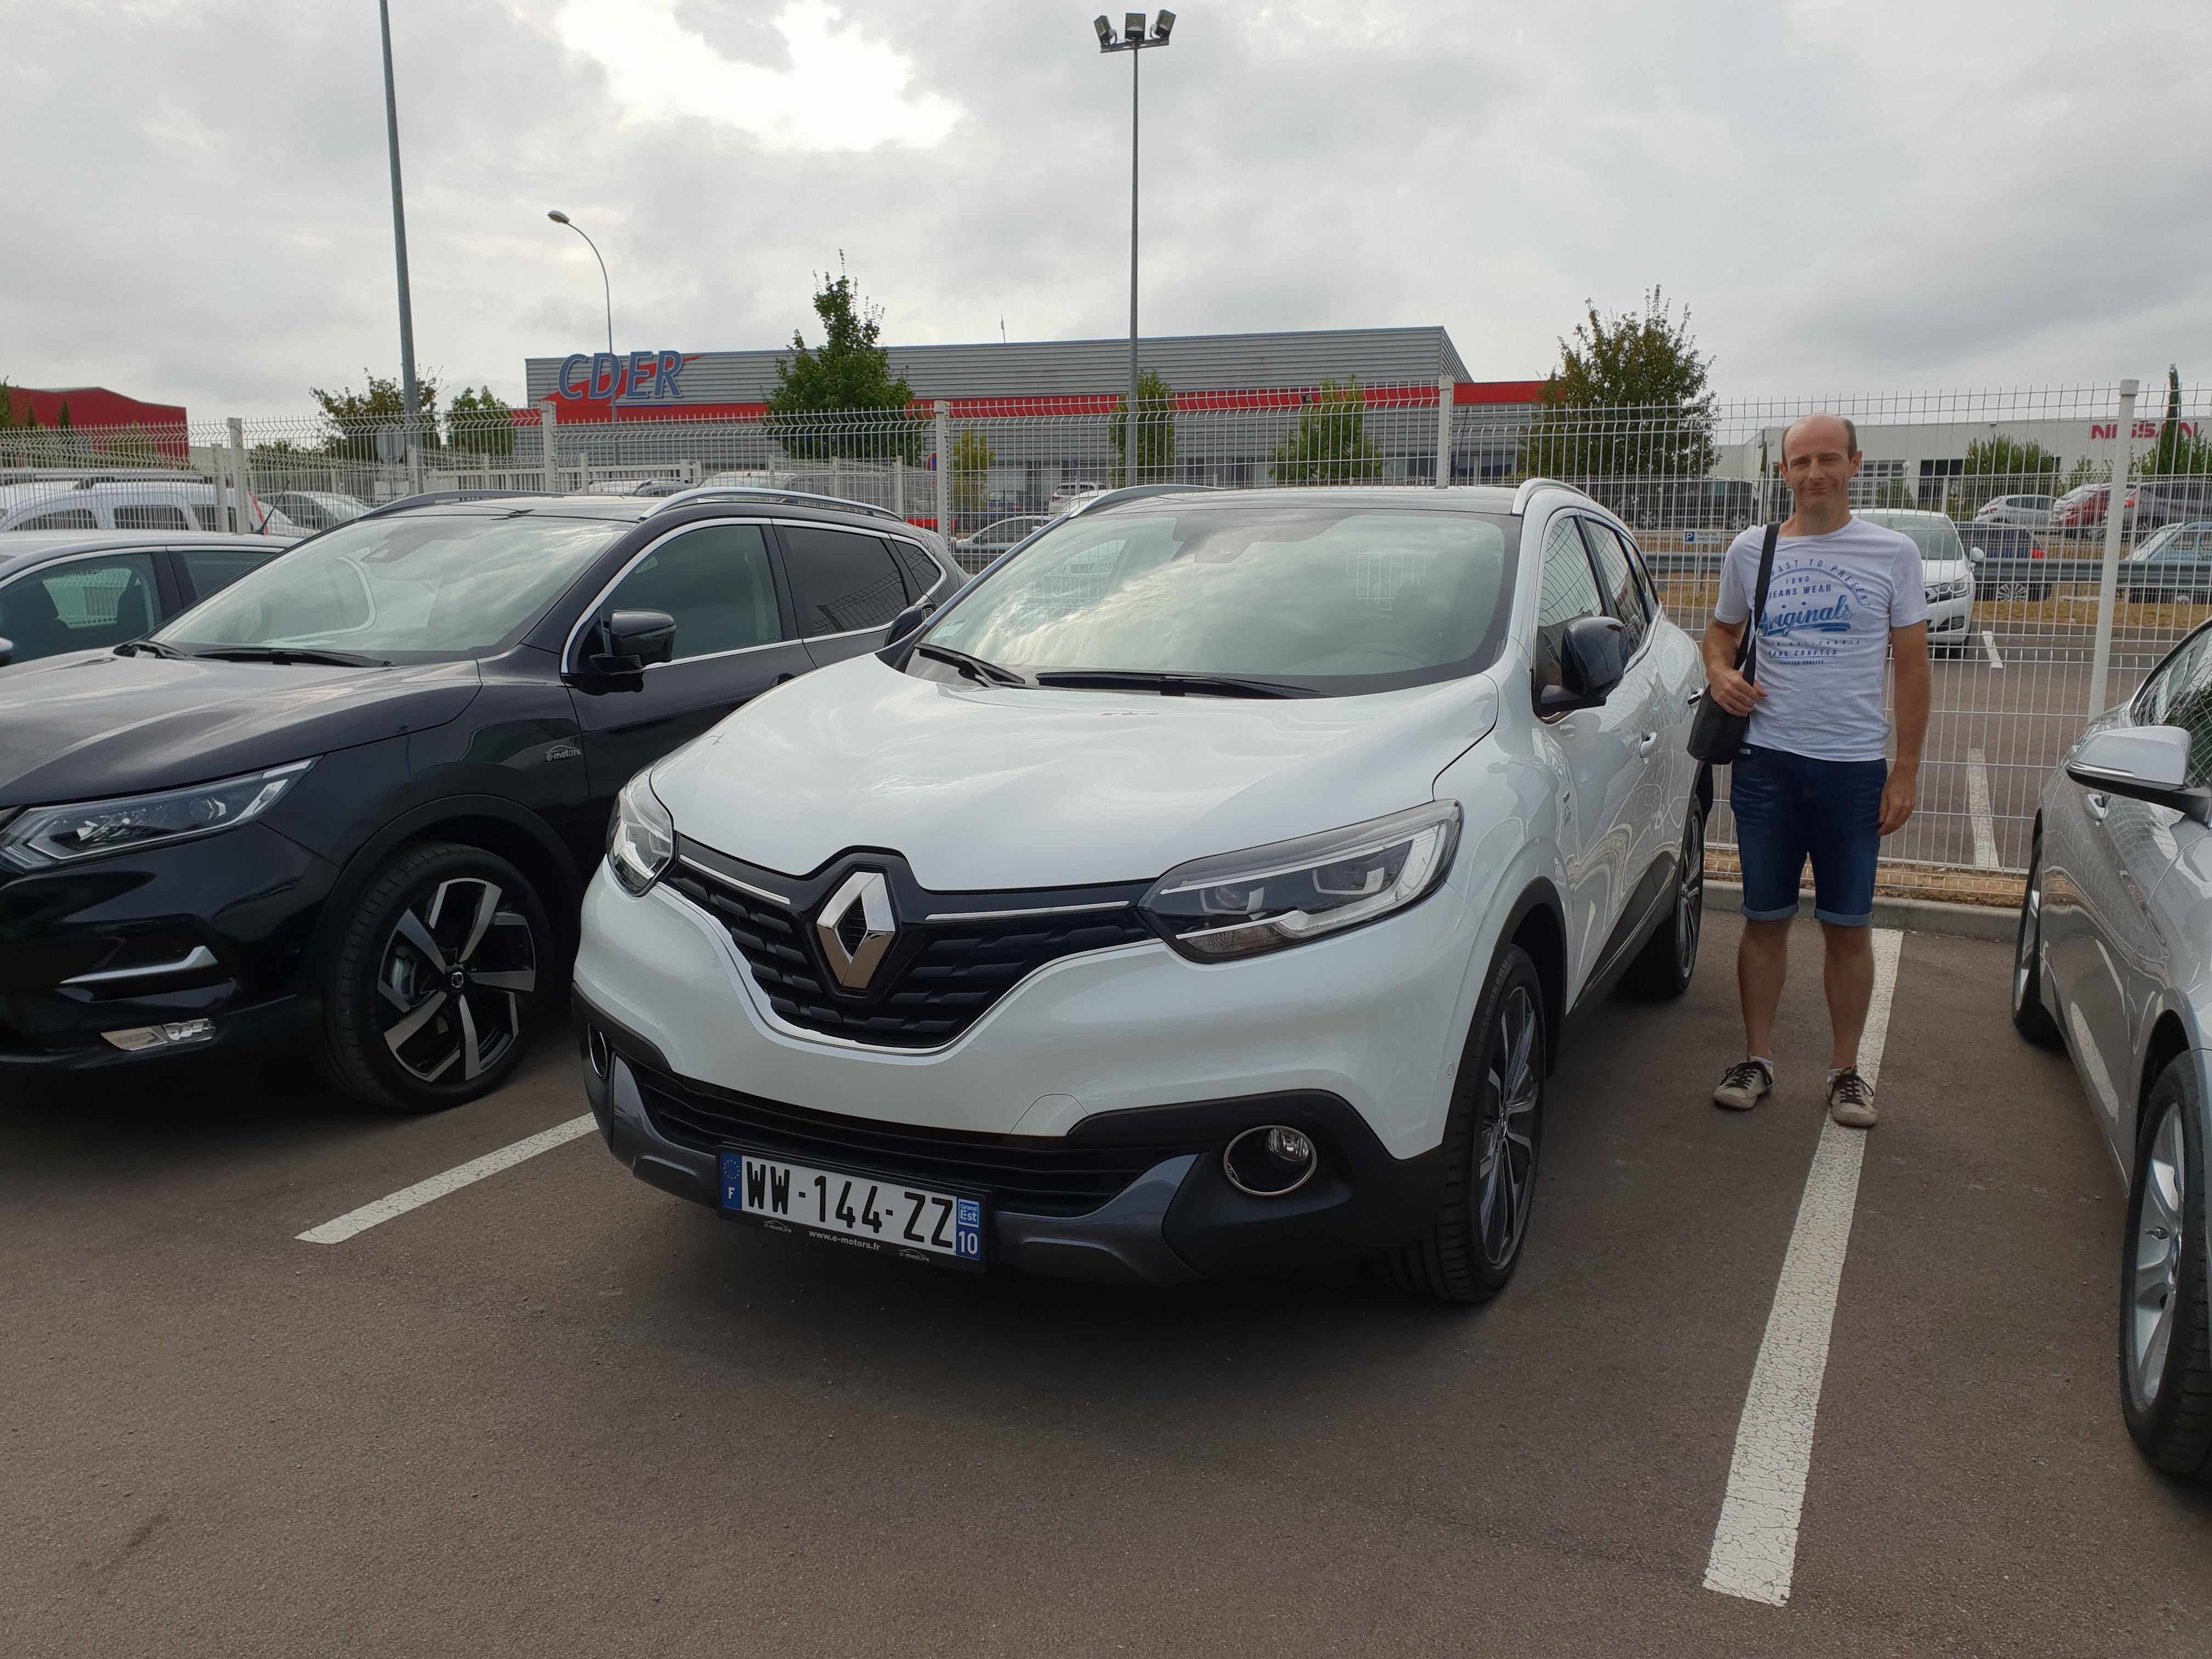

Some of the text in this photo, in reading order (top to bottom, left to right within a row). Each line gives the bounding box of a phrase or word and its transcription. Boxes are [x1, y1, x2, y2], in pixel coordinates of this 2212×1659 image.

[557, 351, 684, 400] CDER
[1768, 588, 1798, 600] JEANS
[1803, 584, 1831, 594] WEAR
[1771, 558, 1870, 606] PAST TO PRESENT
[728, 1161, 953, 1249] F WW-144-ZZ
[960, 1209, 977, 1222] Est
[808, 1229, 881, 1251] www.e-motors.fr
[958, 1231, 978, 1255] 10
